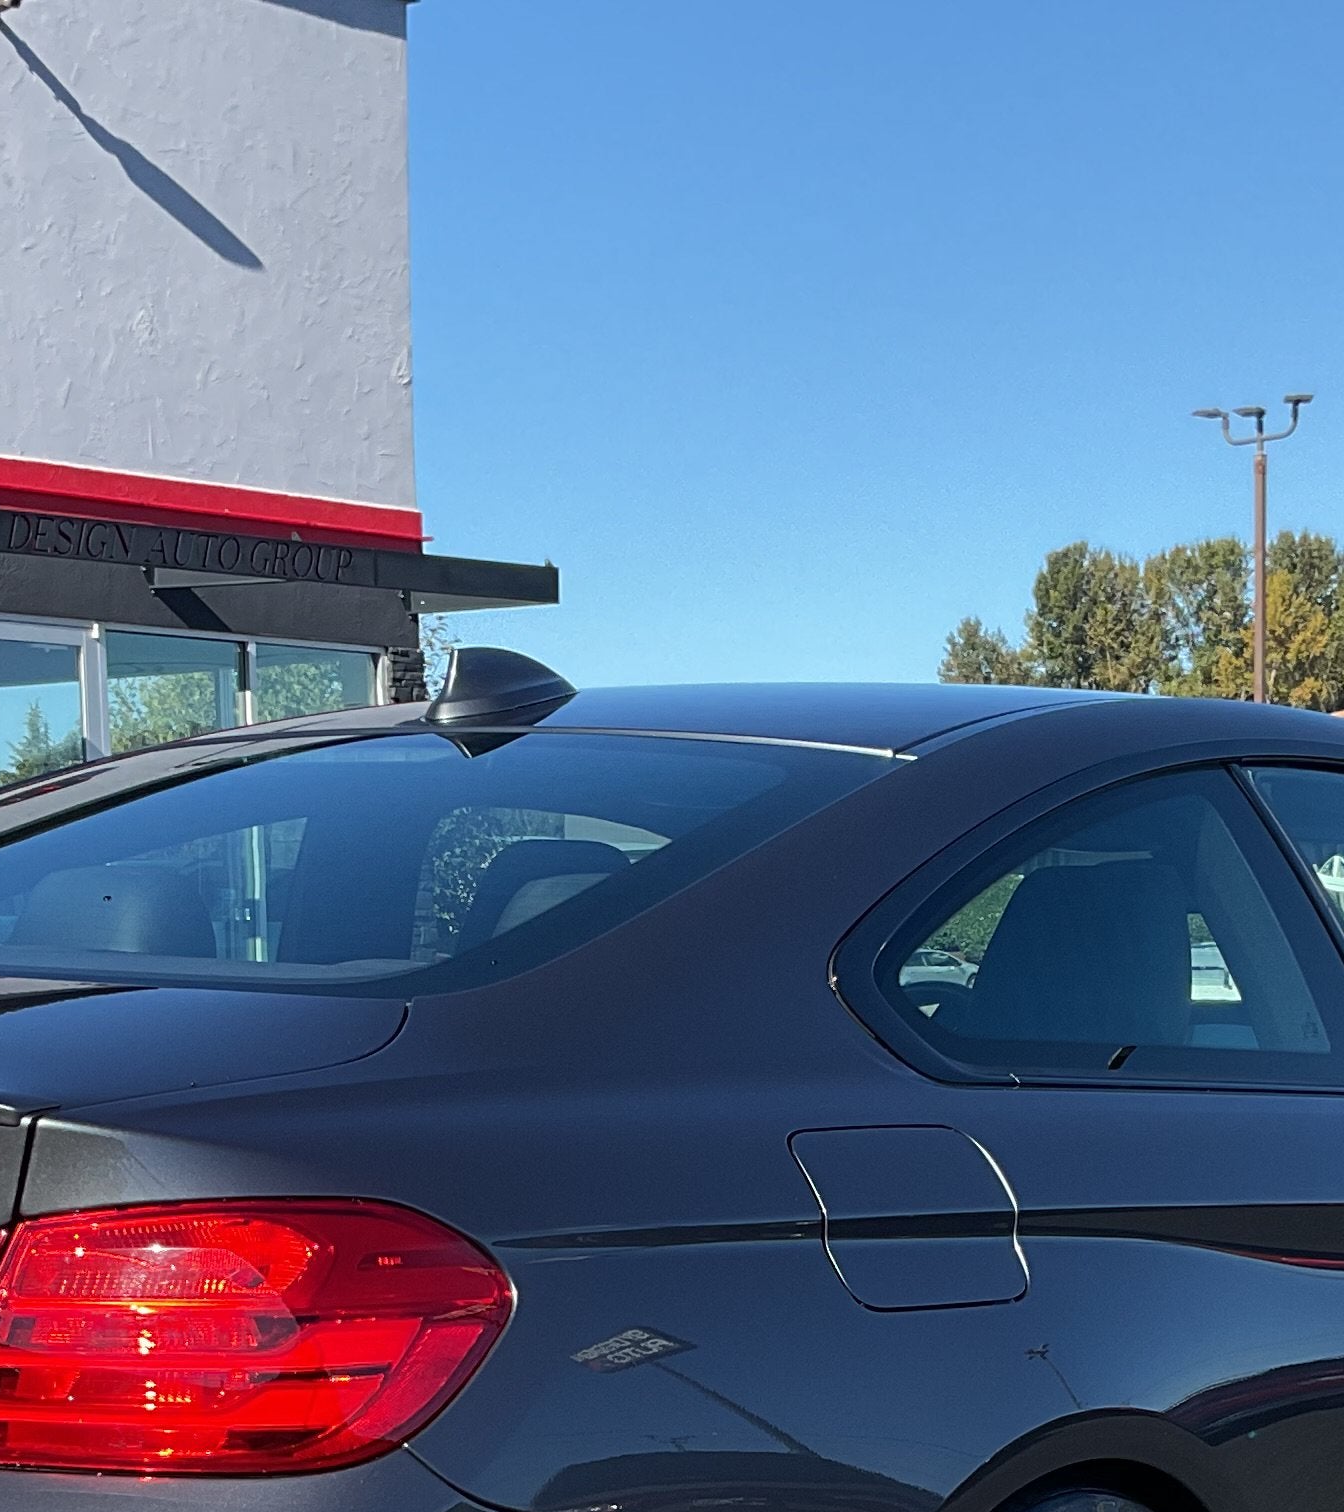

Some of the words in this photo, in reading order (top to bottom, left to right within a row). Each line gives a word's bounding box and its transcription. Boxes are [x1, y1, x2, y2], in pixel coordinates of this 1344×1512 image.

[7, 512, 137, 561] DESIGN
[144, 529, 243, 572] AUTO
[250, 538, 355, 582] GROUP
